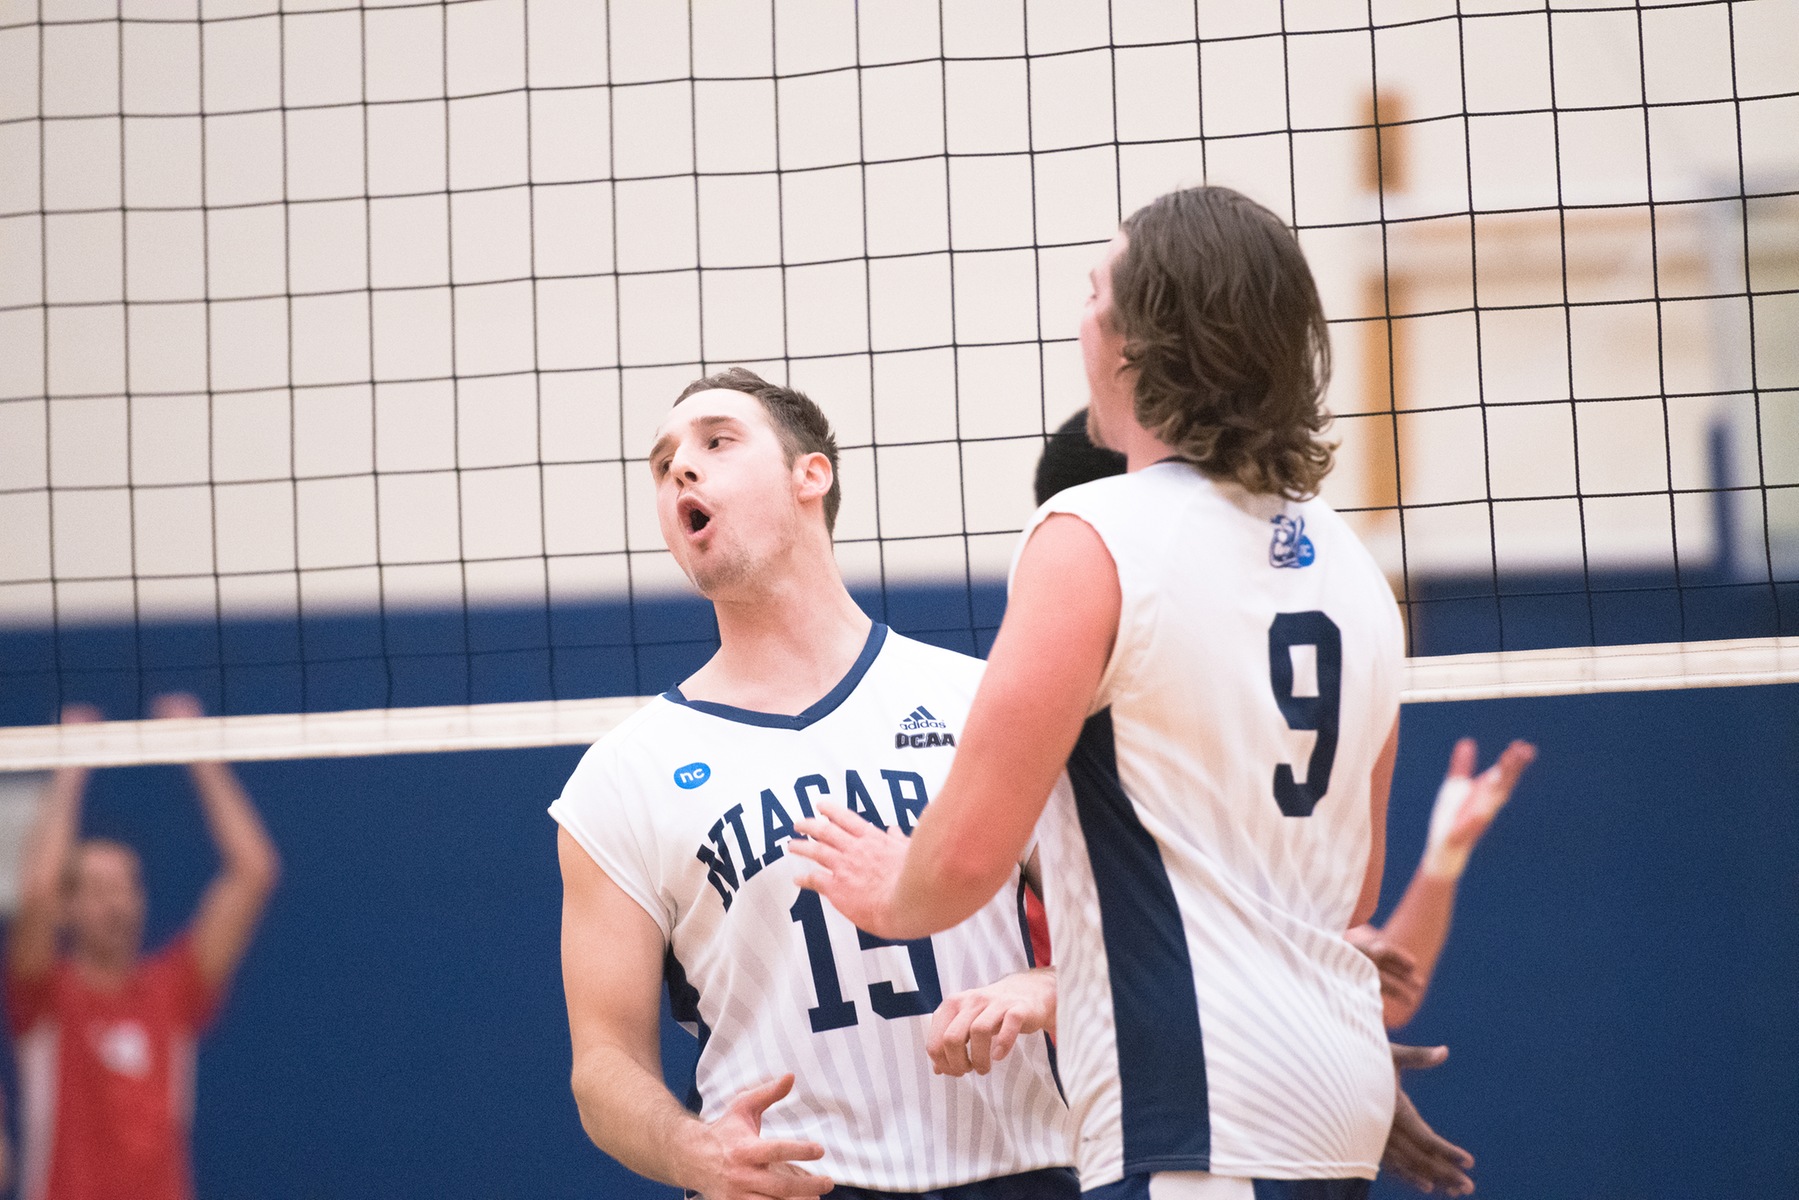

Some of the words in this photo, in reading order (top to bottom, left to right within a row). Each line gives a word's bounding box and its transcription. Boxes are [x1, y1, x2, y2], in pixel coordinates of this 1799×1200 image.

[680, 768, 705, 783] nc
[900, 719, 947, 730] adidas
[1268, 610, 1342, 817] 9
[696, 769, 929, 911] NIAGAR
[790, 887, 943, 1033] 15
